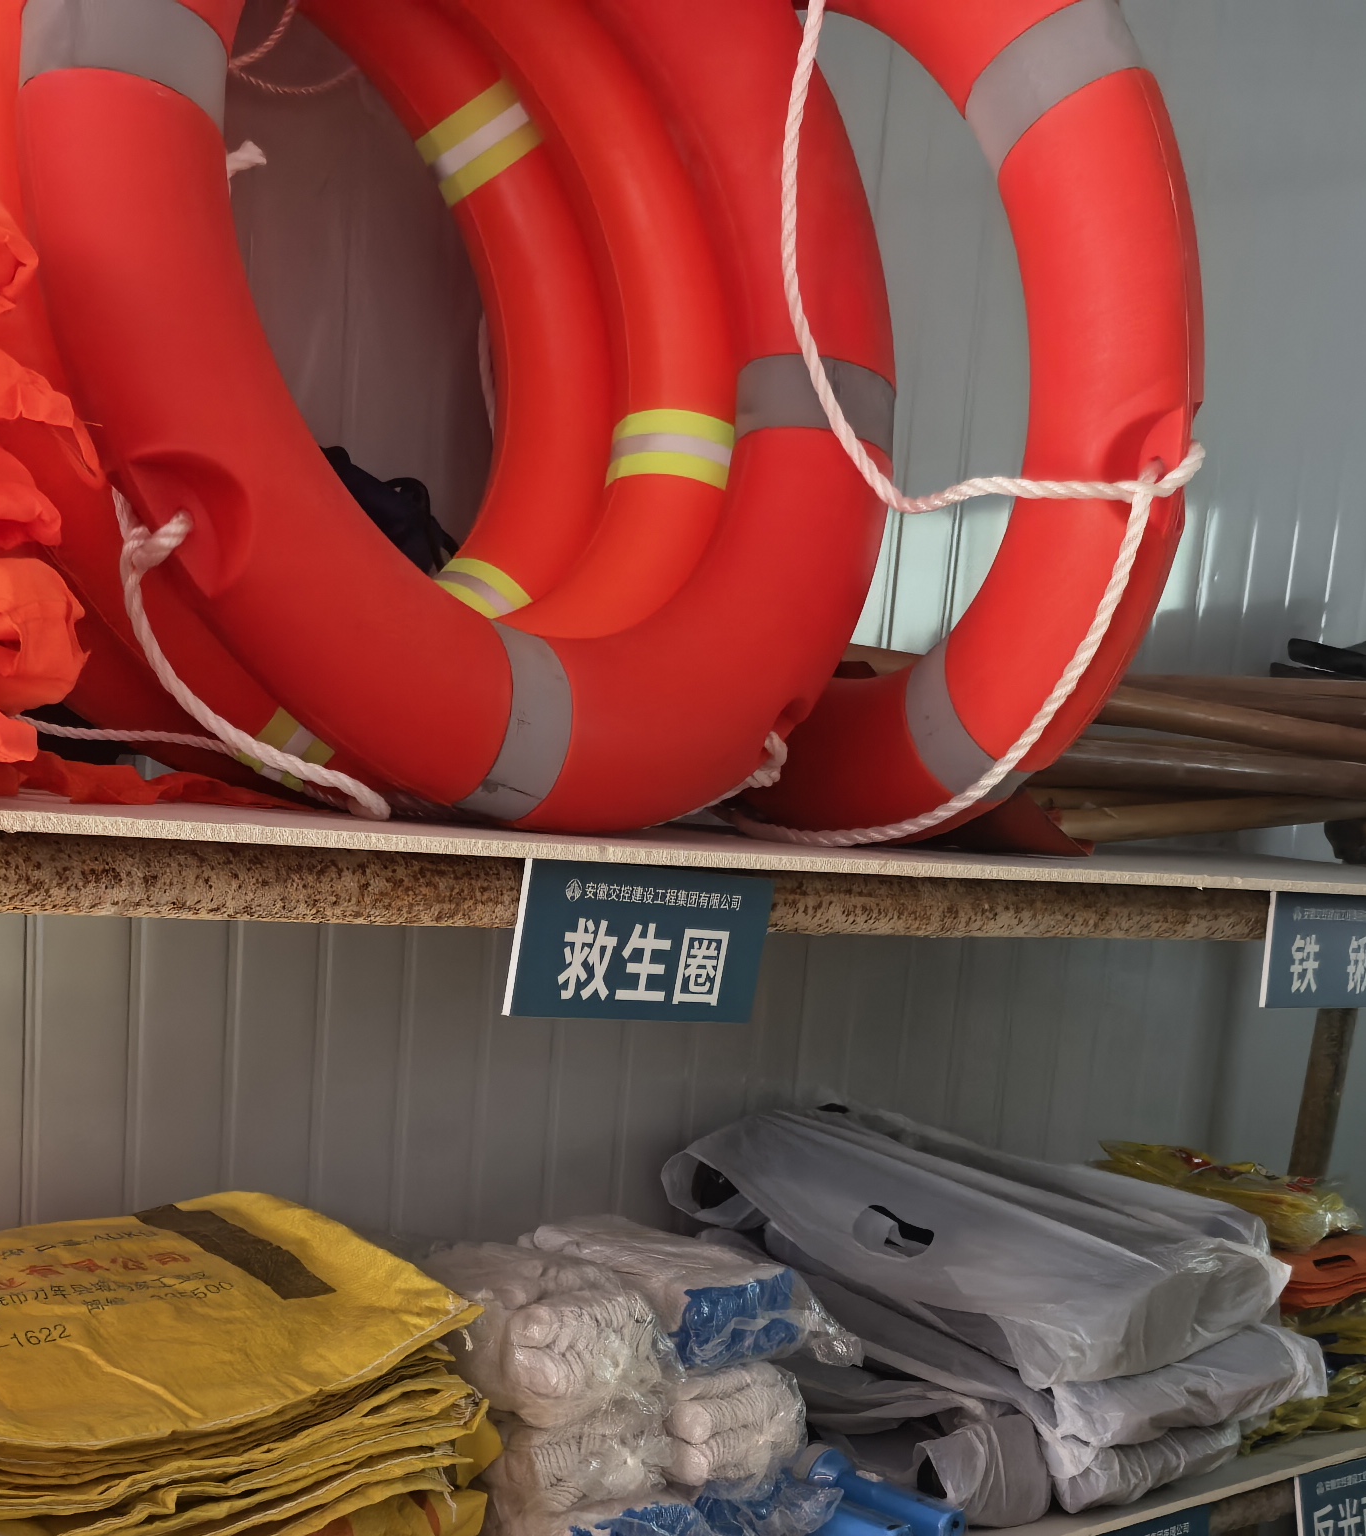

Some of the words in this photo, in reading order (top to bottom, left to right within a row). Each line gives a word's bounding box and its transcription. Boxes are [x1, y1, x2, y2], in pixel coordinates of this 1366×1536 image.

[585, 882, 742, 911] 安徽交控建设工程集团有限公司
[557, 917, 730, 1006] 救生圈
